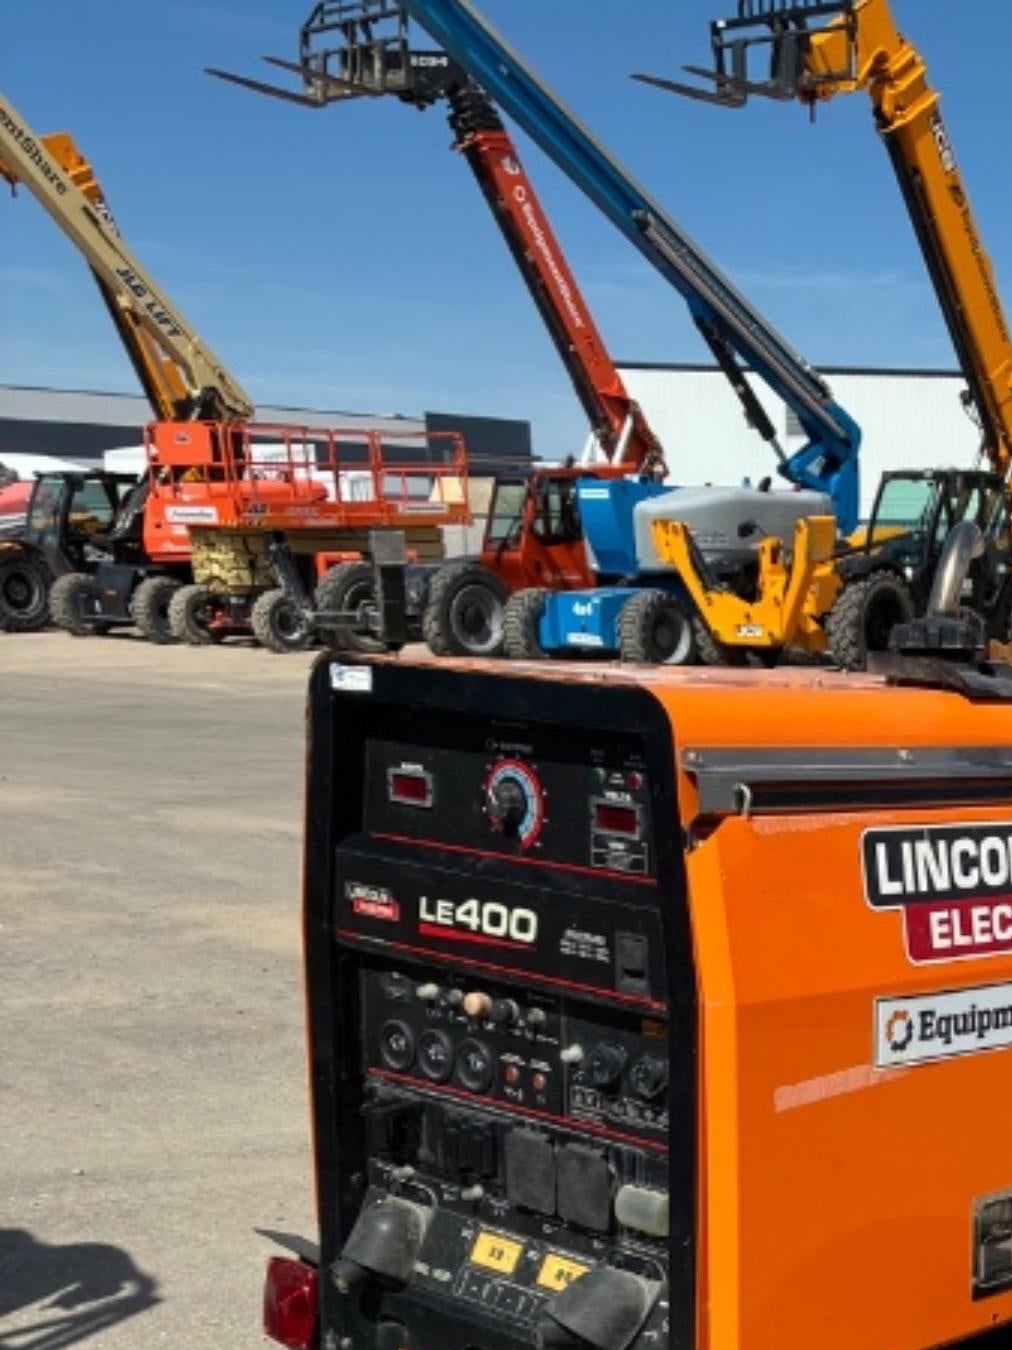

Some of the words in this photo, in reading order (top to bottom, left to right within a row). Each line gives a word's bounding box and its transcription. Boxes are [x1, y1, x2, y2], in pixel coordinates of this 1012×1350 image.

[116, 266, 147, 298] JLG
[146, 301, 181, 337] LIFT
[418, 895, 538, 944] LE400
